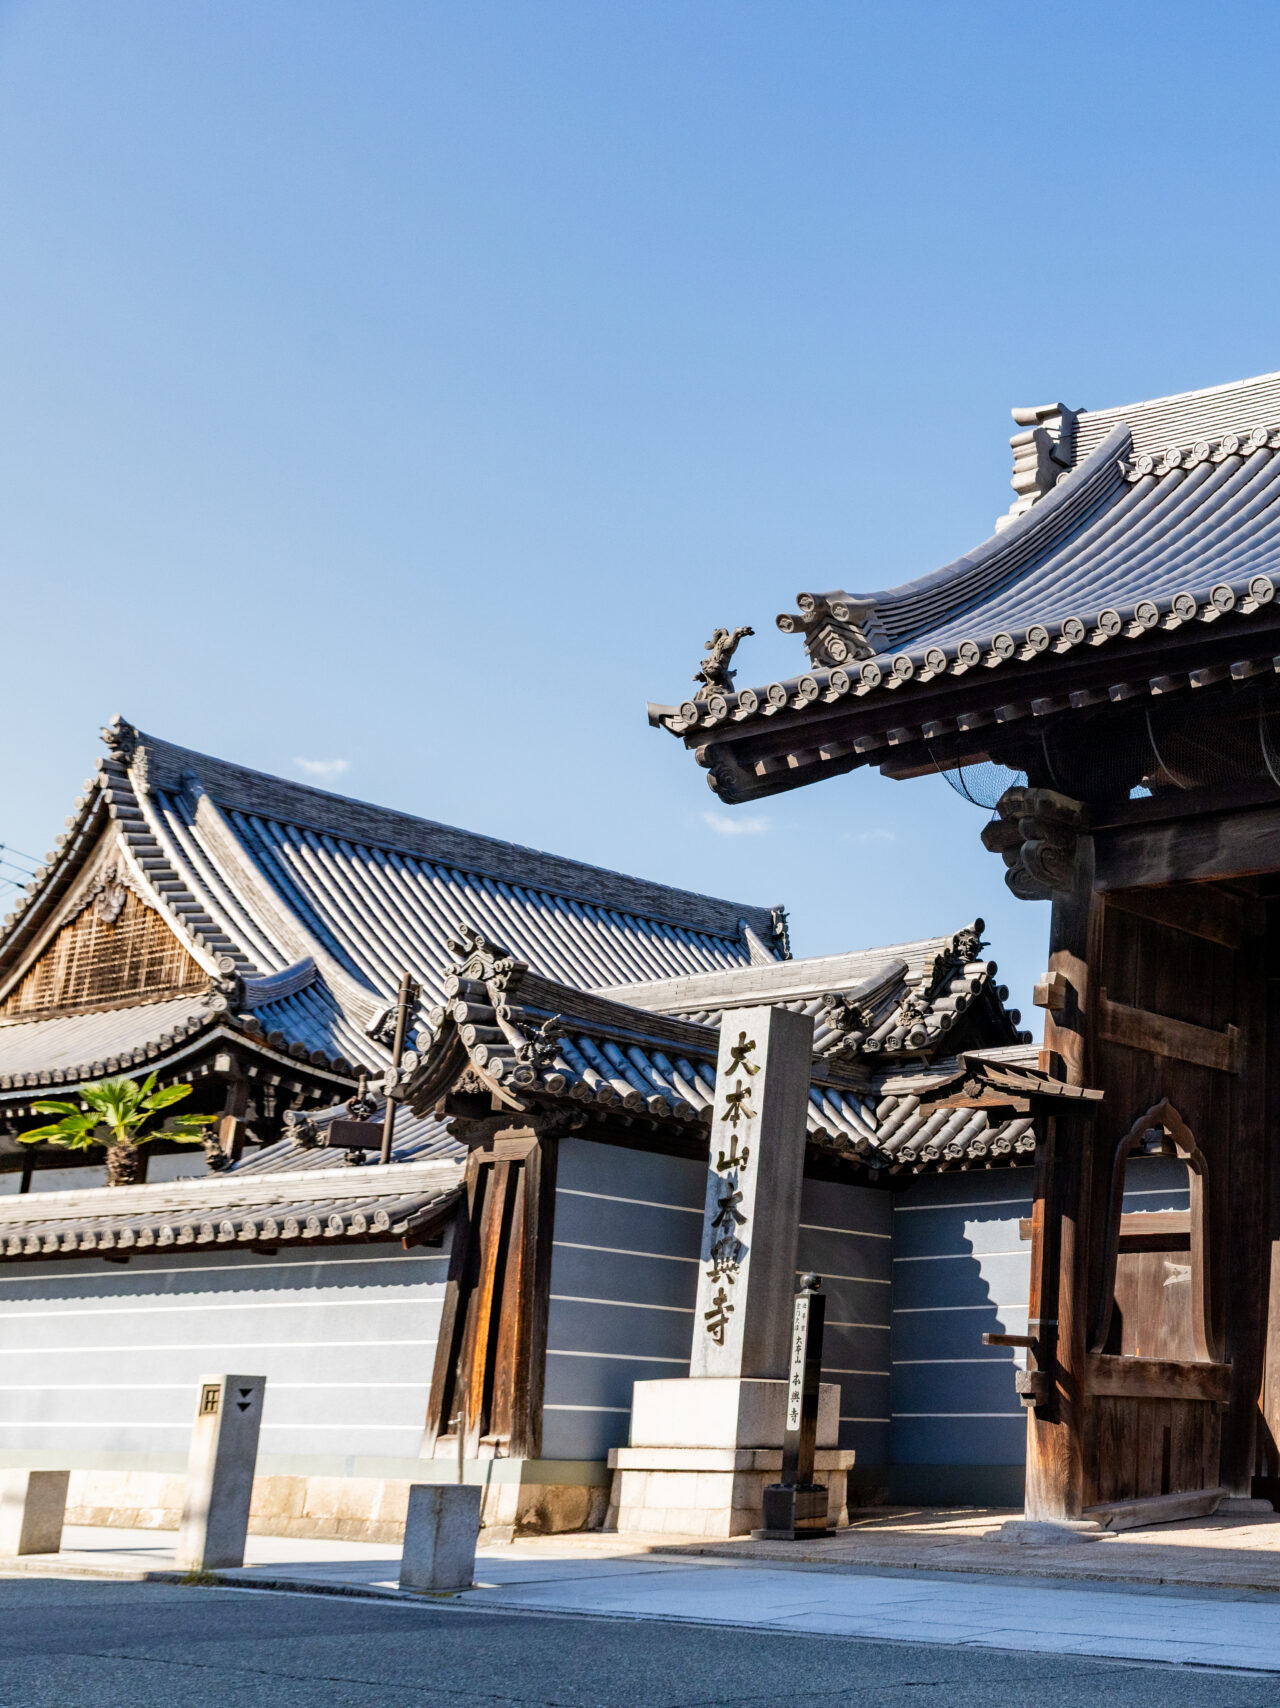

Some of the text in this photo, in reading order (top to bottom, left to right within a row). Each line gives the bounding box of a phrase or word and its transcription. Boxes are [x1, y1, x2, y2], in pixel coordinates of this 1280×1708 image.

[704, 1031, 761, 1346] 大本山本興寺
